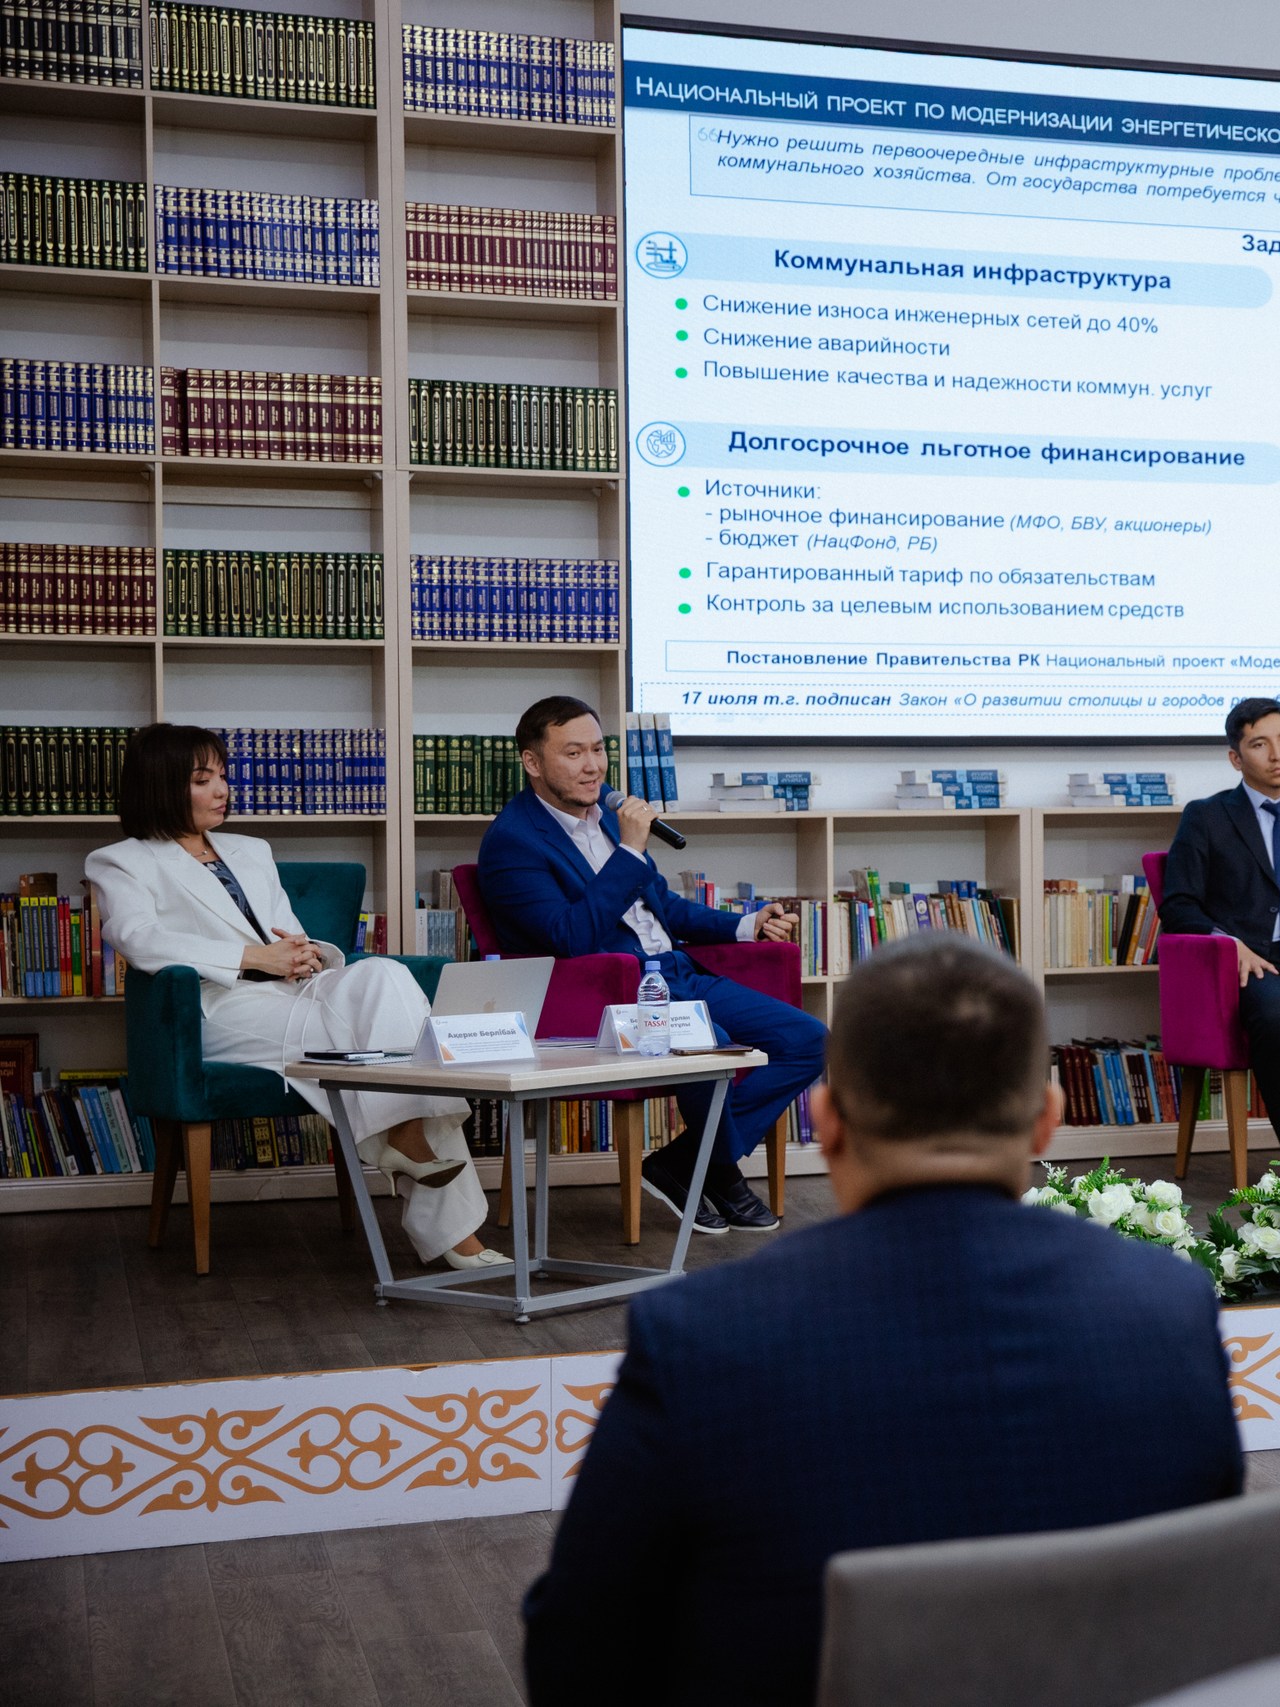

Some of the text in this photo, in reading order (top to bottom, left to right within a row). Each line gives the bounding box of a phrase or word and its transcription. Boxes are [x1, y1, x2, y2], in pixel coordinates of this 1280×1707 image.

[636, 76, 818, 110] НАЦИОНАЛЬНЫЙ
[827, 95, 908, 117] ПРОЕКТ
[915, 102, 945, 120] ПО
[951, 104, 1113, 134] МОДЕРНИЗАЦИИ
[717, 129, 779, 149] Нужно
[785, 137, 864, 155] решить
[872, 144, 1025, 166] первоочередные
[1033, 154, 1215, 180] инфраструктурные
[717, 155, 865, 177] коммунального
[872, 166, 975, 184] хозяйства.
[986, 171, 1017, 187] От
[1022, 176, 1138, 196] государства
[1146, 184, 1266, 204] потребуется
[775, 249, 1171, 292] Коммунальная инфраструктура
[703, 294, 1158, 334] Снижение износа инженерных сетей до 40%
[703, 327, 950, 356] Снижение аварийности
[704, 360, 1213, 401] Повышение качества и надежности коммун. услуг
[728, 430, 1245, 468] Долгосрочное льготное финансирование
[705, 478, 822, 499] Источники:
[719, 508, 1212, 536] рыночное финансирование (МФО, БВУ, акционеры)
[719, 528, 938, 554] бюджет (НацФонд, РБ)
[706, 561, 1155, 587] Гарантированный тариф по обязательствам
[707, 593, 1184, 621] Контроль за целевым использованием средств
[727, 650, 868, 666] Постановление
[876, 652, 1011, 669] Правительства
[1018, 653, 1040, 667] РК
[1046, 653, 1165, 669] Национальный
[1172, 657, 1225, 670] проект
[682, 690, 703, 705] 17
[707, 694, 758, 706] июля
[763, 695, 799, 706] т.г.
[805, 692, 892, 706] подписан
[899, 692, 948, 706] Закон
[954, 693, 977, 707] «О
[981, 696, 1063, 709] развитии
[1068, 696, 1143, 708] столицы
[1147, 697, 1157, 707] и
[1161, 693, 1225, 709] городов
[644, 1020, 668, 1028] TASSAY
